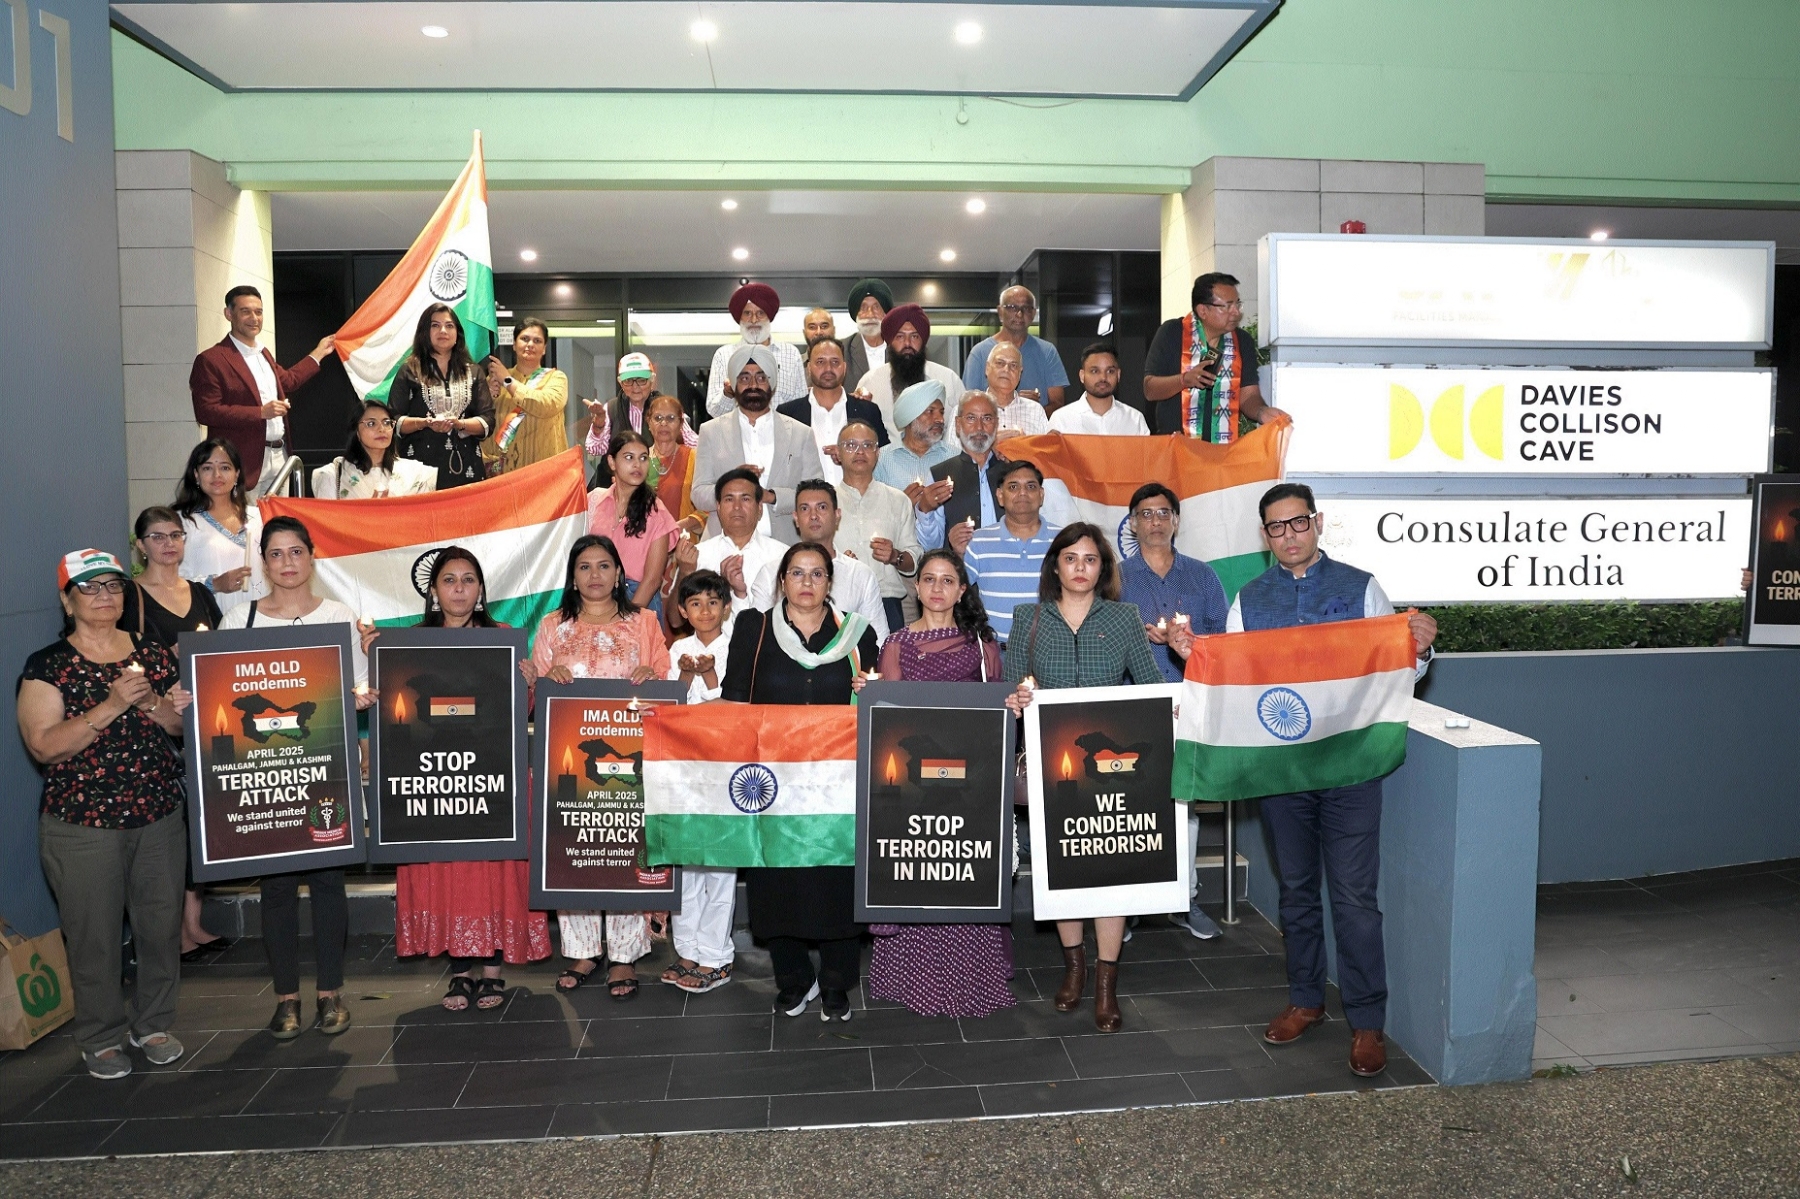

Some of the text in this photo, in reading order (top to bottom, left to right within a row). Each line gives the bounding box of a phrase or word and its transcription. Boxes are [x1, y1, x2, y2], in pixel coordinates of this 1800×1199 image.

[1521, 385, 1622, 406] DAVIES
[1520, 413, 1662, 434] COLLISON
[1520, 440, 1594, 461] CAVE
[1376, 511, 1726, 543] Consulate General
[1477, 554, 1624, 587] of India
[236, 660, 300, 678] IMA QLD
[232, 678, 306, 692] condemns
[583, 710, 610, 722] IMA
[580, 725, 644, 736] condemns
[247, 746, 304, 760] APRIL 2025
[419, 752, 476, 772] STOP
[212, 762, 258, 772] PAHALGAM,
[260, 759, 287, 768] JAMMU
[296, 755, 332, 764] KASHMIR
[218, 766, 327, 791] TERRORISM
[388, 774, 504, 795] TERRORISM
[239, 785, 310, 806] ATTACK
[587, 791, 637, 800] APRIL 2025
[1095, 793, 1126, 812] WE
[227, 806, 306, 822] We stand united
[406, 797, 489, 816] IN INDIA
[556, 801, 595, 810] PAHALGAM,
[236, 819, 303, 834] against terror
[908, 815, 964, 835] STOP
[1064, 813, 1156, 835] CONDEMN
[577, 828, 639, 843] ATTACK
[1059, 833, 1163, 857] TERRORISM
[566, 848, 634, 856] We stand united
[877, 839, 992, 859] TERRORISM
[572, 858, 631, 868] against terror
[894, 862, 975, 881] IN INDIA
